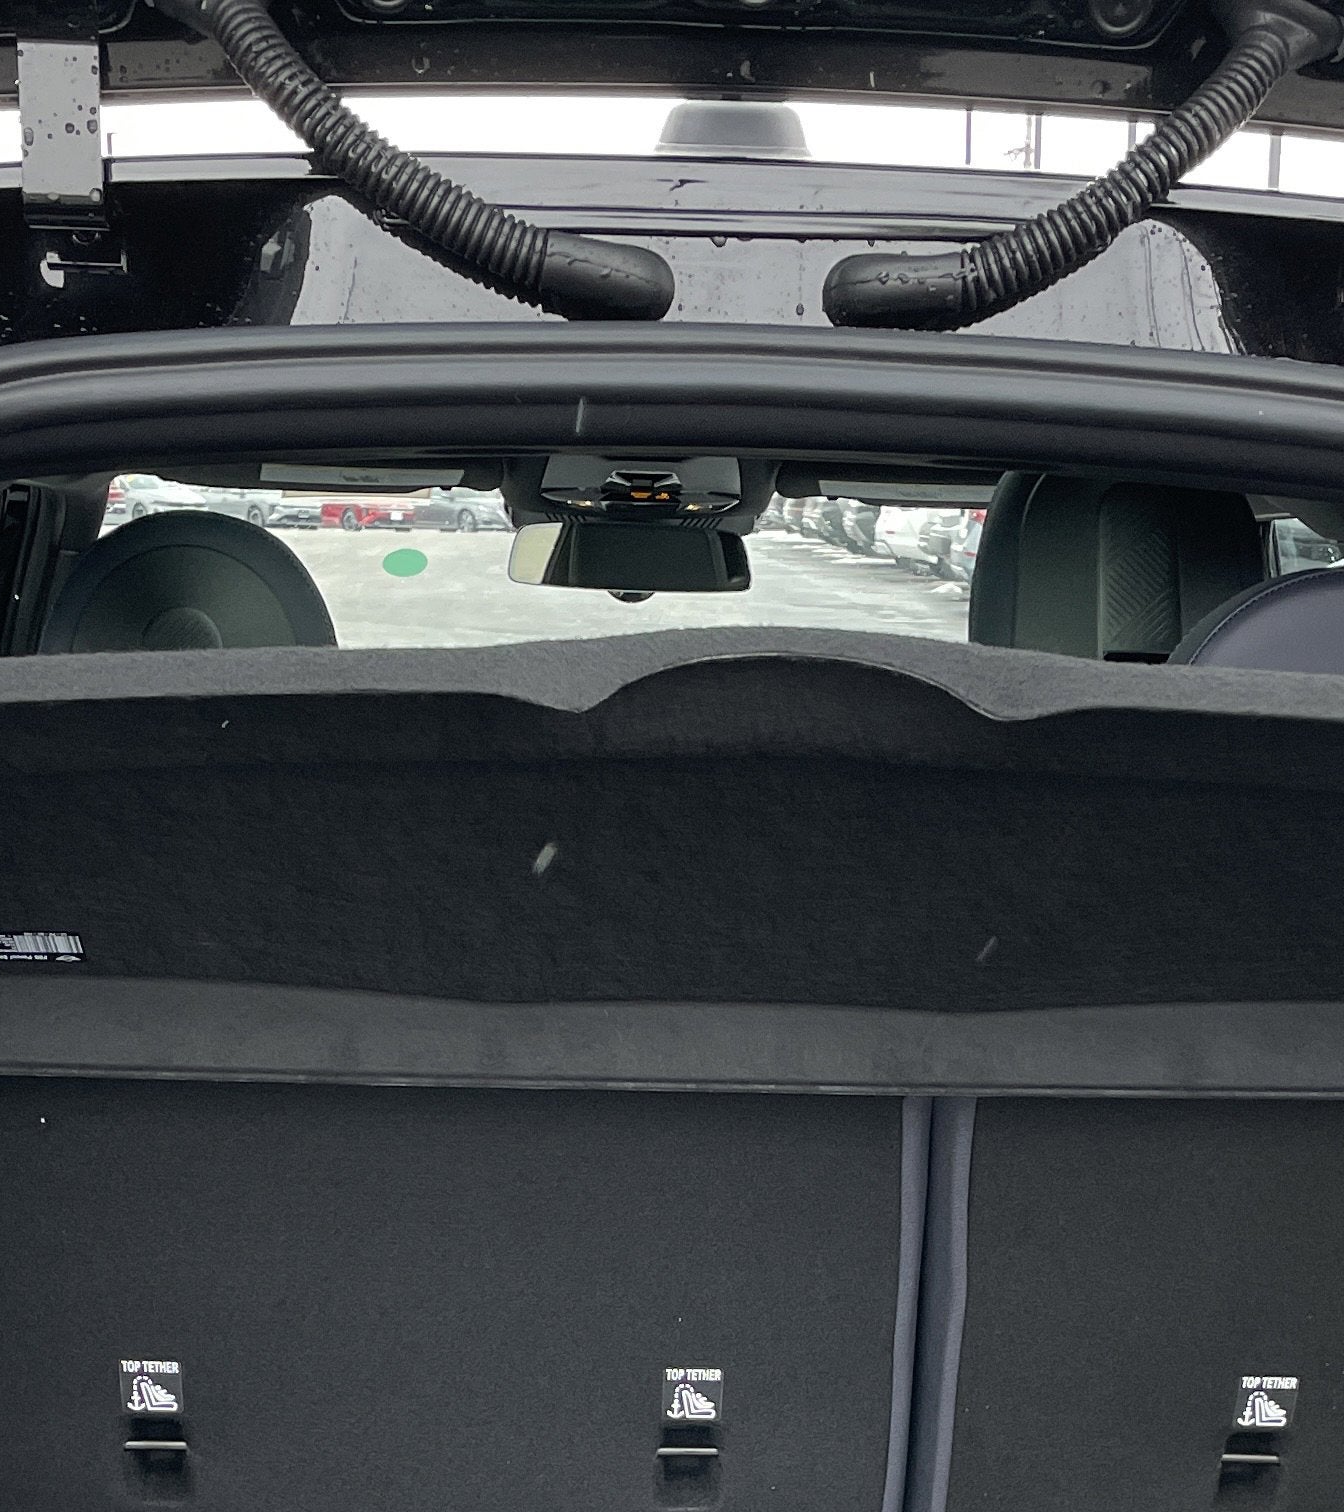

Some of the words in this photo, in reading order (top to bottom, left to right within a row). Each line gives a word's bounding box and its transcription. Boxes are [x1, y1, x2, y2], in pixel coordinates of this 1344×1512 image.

[121, 1360, 141, 1373] TOP
[142, 1360, 179, 1373] TETHER
[666, 1368, 685, 1381] TOP
[686, 1368, 721, 1381] TETHER
[1242, 1376, 1261, 1389] TOP
[1262, 1376, 1298, 1389] TETHER
